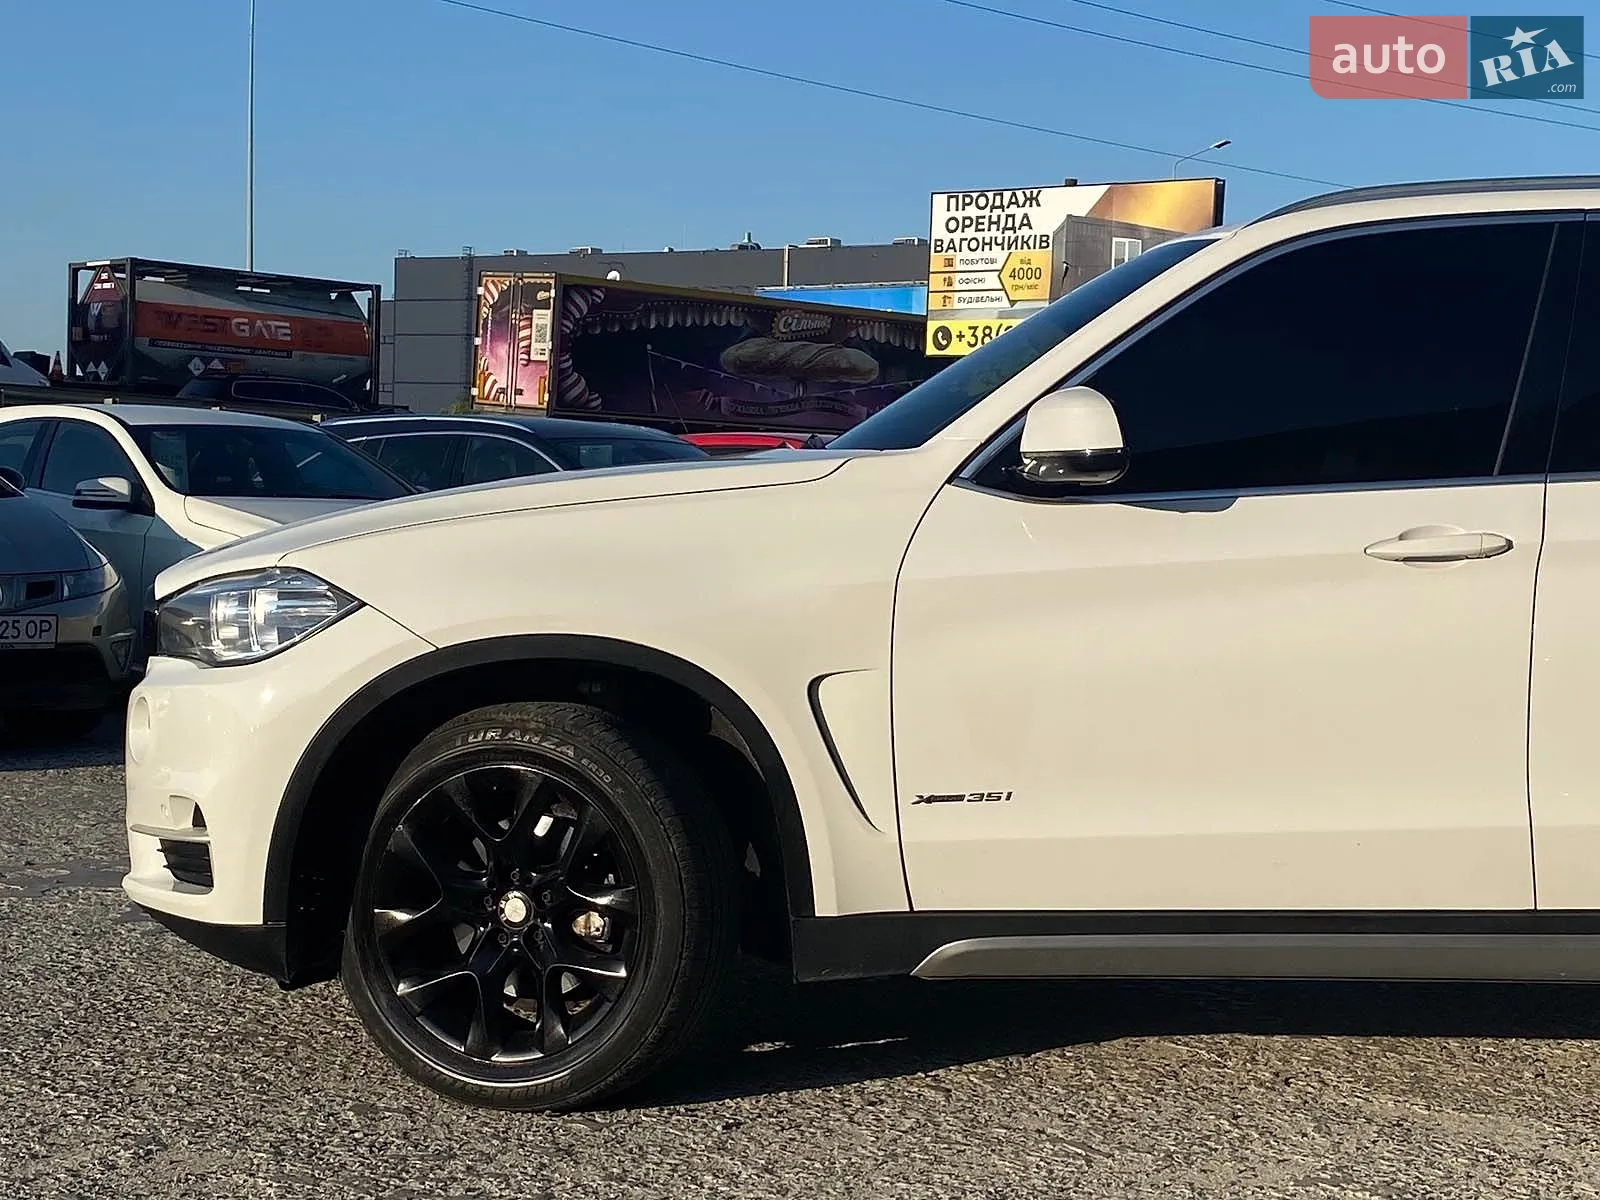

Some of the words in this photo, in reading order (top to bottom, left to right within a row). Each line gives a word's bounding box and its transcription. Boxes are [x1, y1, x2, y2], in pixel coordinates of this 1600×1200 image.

[946, 190, 1042, 213] ПРОДАЖ
[945, 213, 1033, 235] ОРЕНДА
[933, 234, 1050, 253] ВАГОНЧИКІВ
[959, 257, 998, 266] ПОБУТОВІ
[1019, 256, 1032, 265] від
[958, 277, 986, 285] ОФІСНІ
[1008, 267, 1042, 281] 4000
[957, 295, 1003, 304] БУДІВЕЛЬНІ
[455, 727, 575, 758] TURANZA
